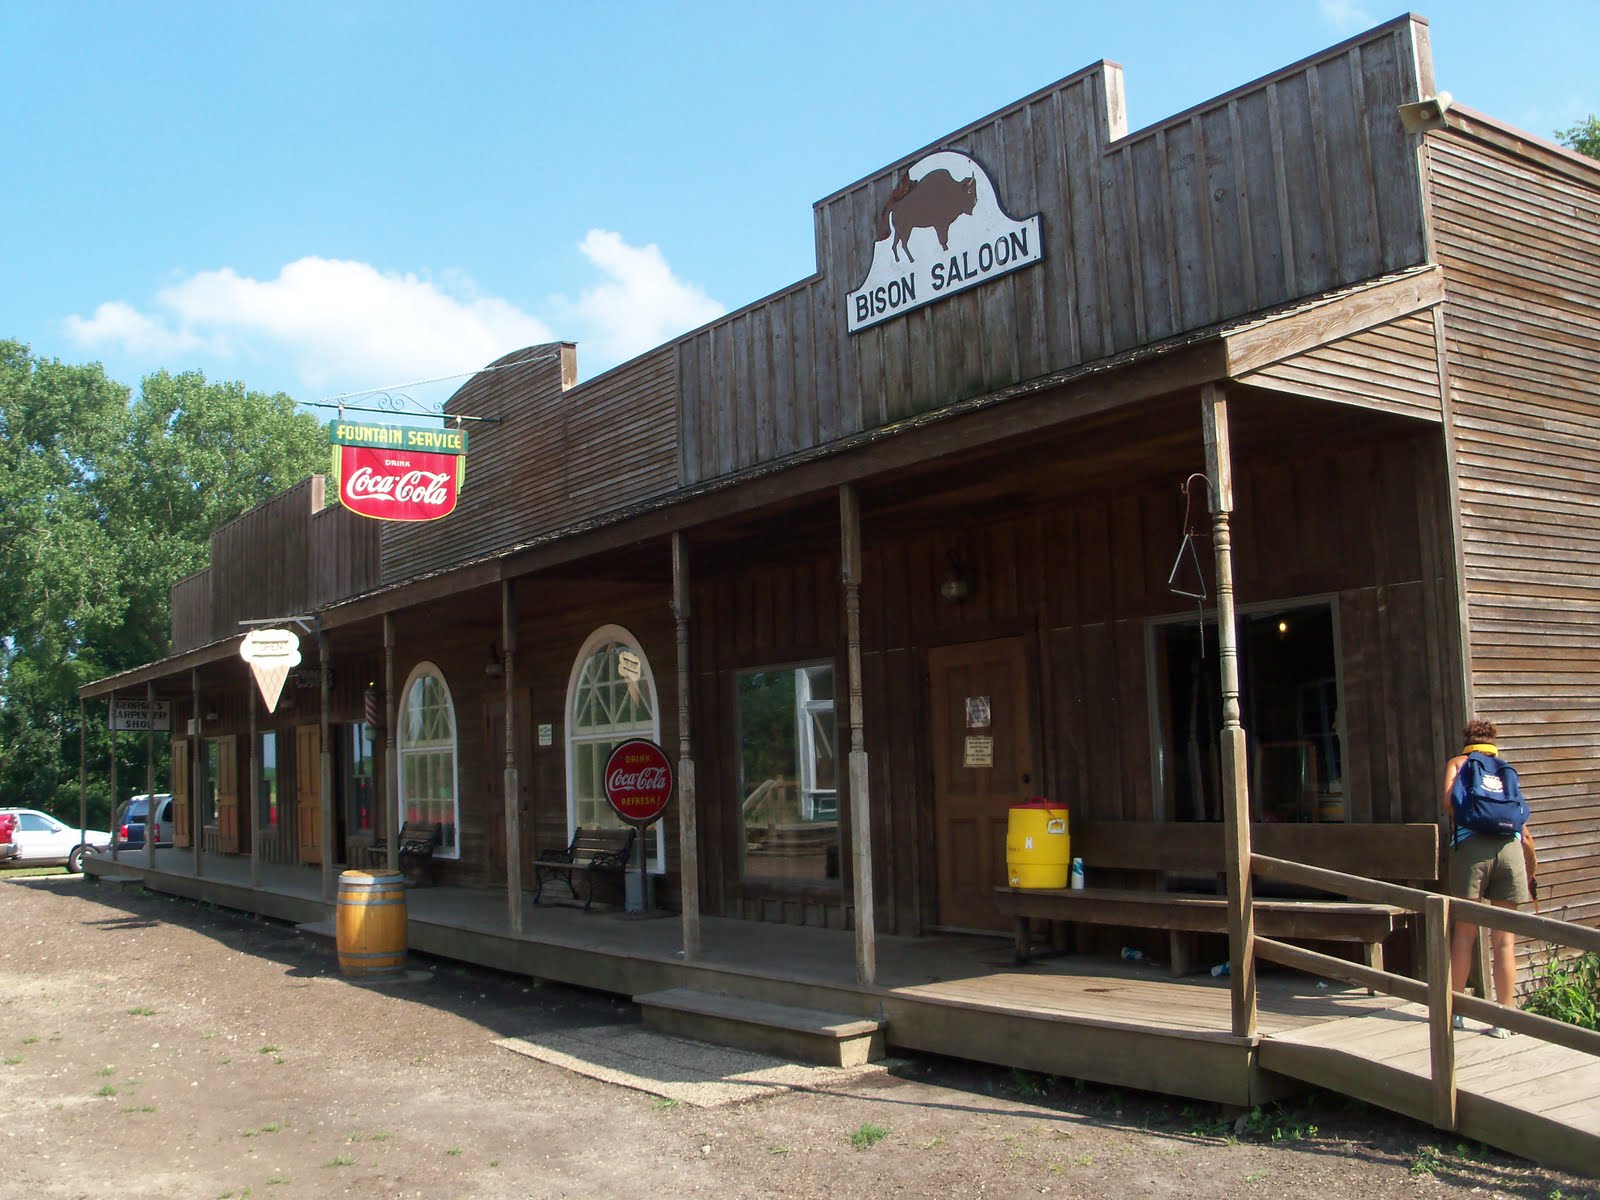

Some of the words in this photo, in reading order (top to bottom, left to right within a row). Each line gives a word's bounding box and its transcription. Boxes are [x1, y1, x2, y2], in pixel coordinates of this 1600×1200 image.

[855, 272, 916, 323] BISON
[931, 227, 1029, 290] SALOON
[336, 425, 403, 444] FOUNTAIN
[408, 430, 462, 449] SERVICE
[384, 459, 411, 467] DRINK
[346, 466, 451, 505] Coca-Cola
[112, 710, 167, 719] ARPENER
[625, 754, 651, 763] DRINK
[608, 766, 667, 792] Coca-Cola
